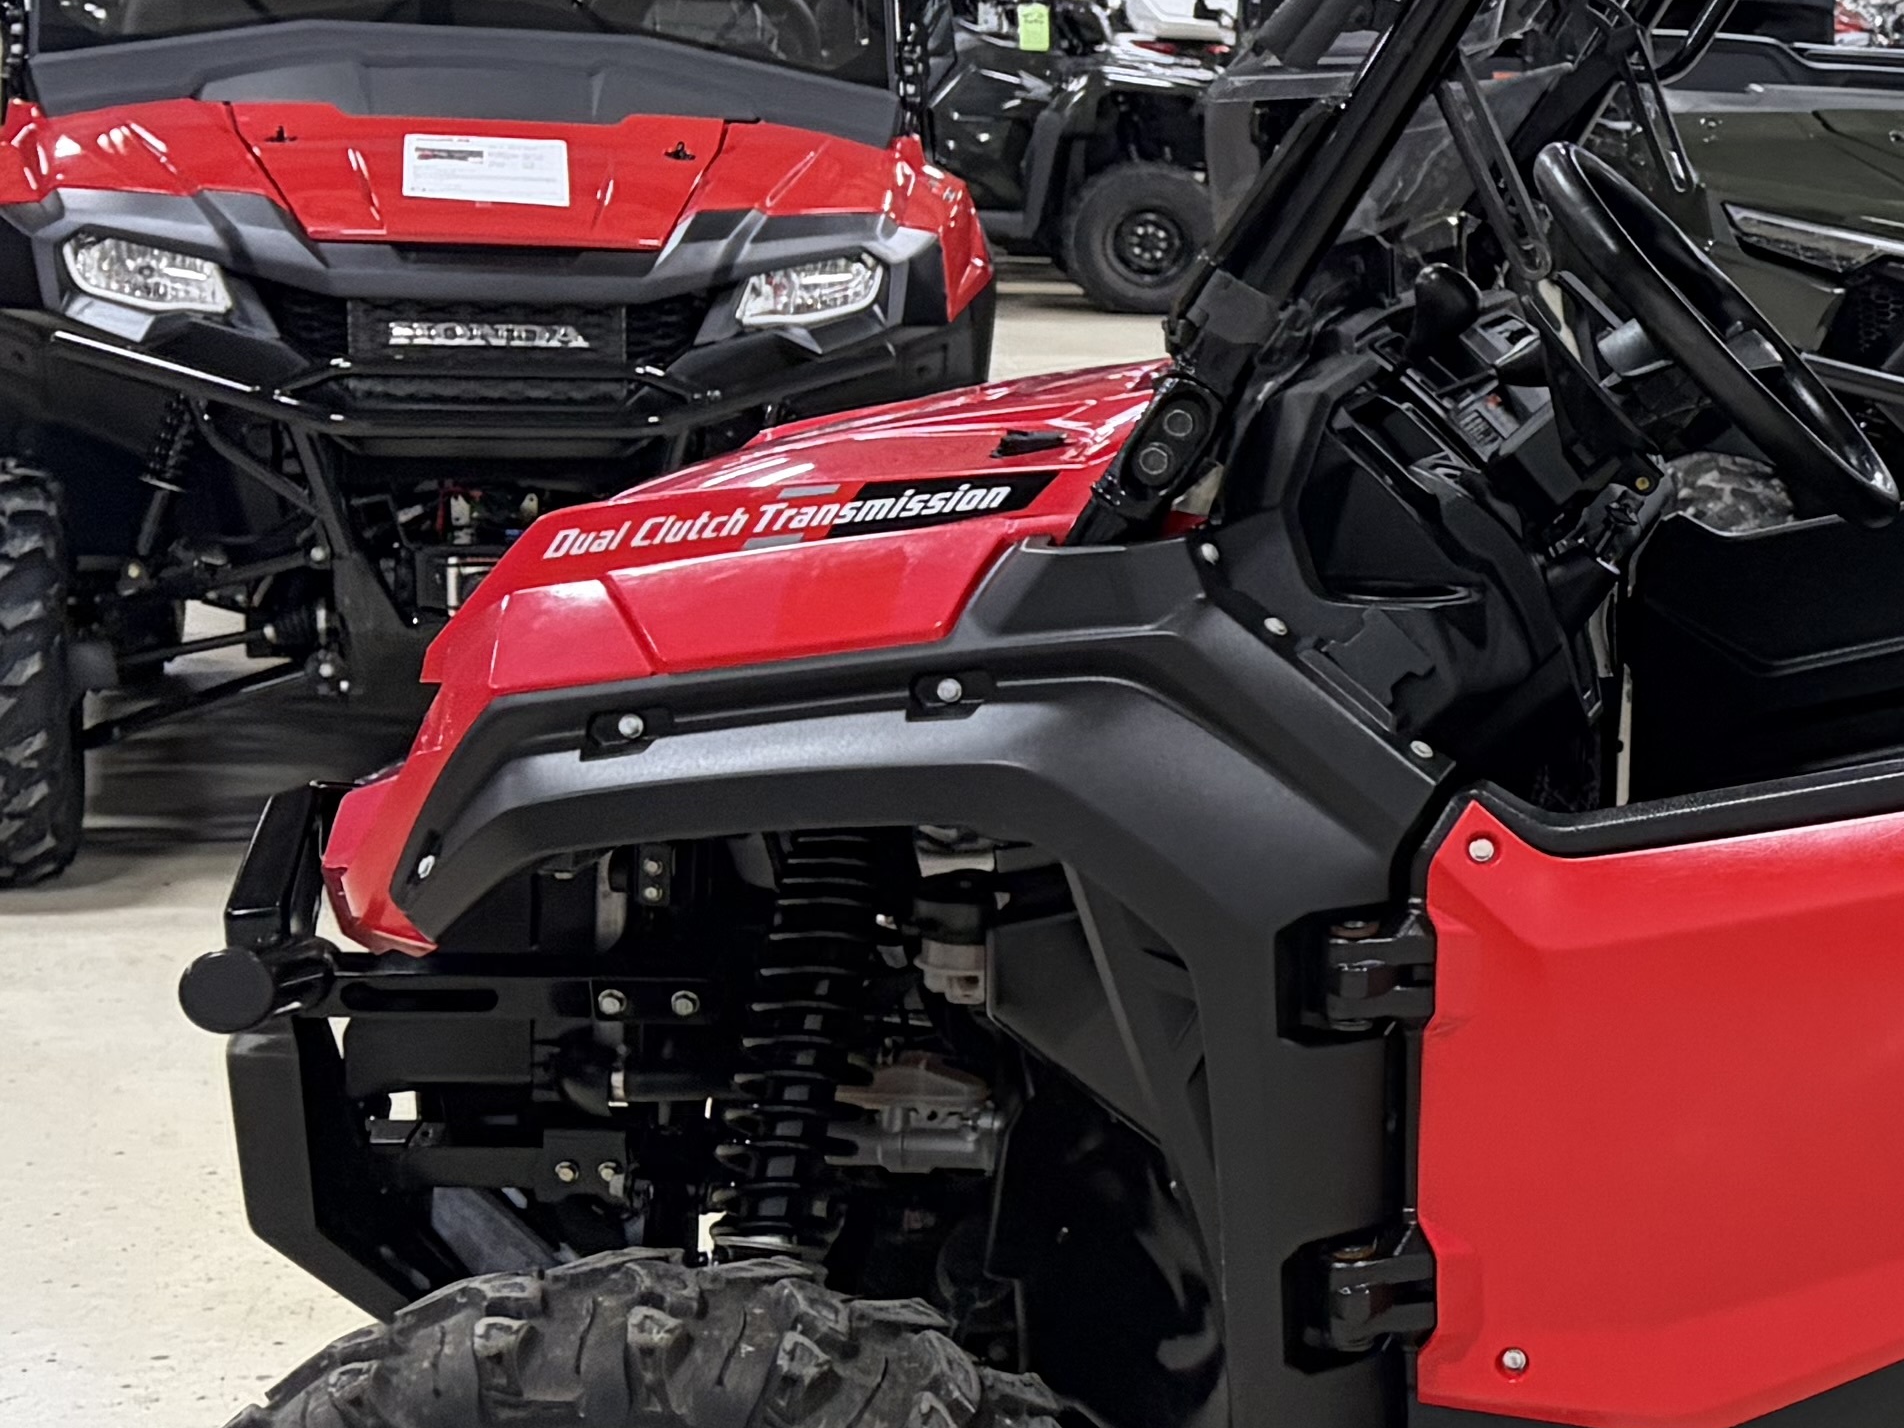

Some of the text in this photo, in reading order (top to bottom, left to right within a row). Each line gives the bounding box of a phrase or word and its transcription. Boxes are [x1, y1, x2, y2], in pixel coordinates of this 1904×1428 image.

[388, 322, 590, 348] HONDA
[543, 483, 1011, 560] Dual Clutch Transmission
